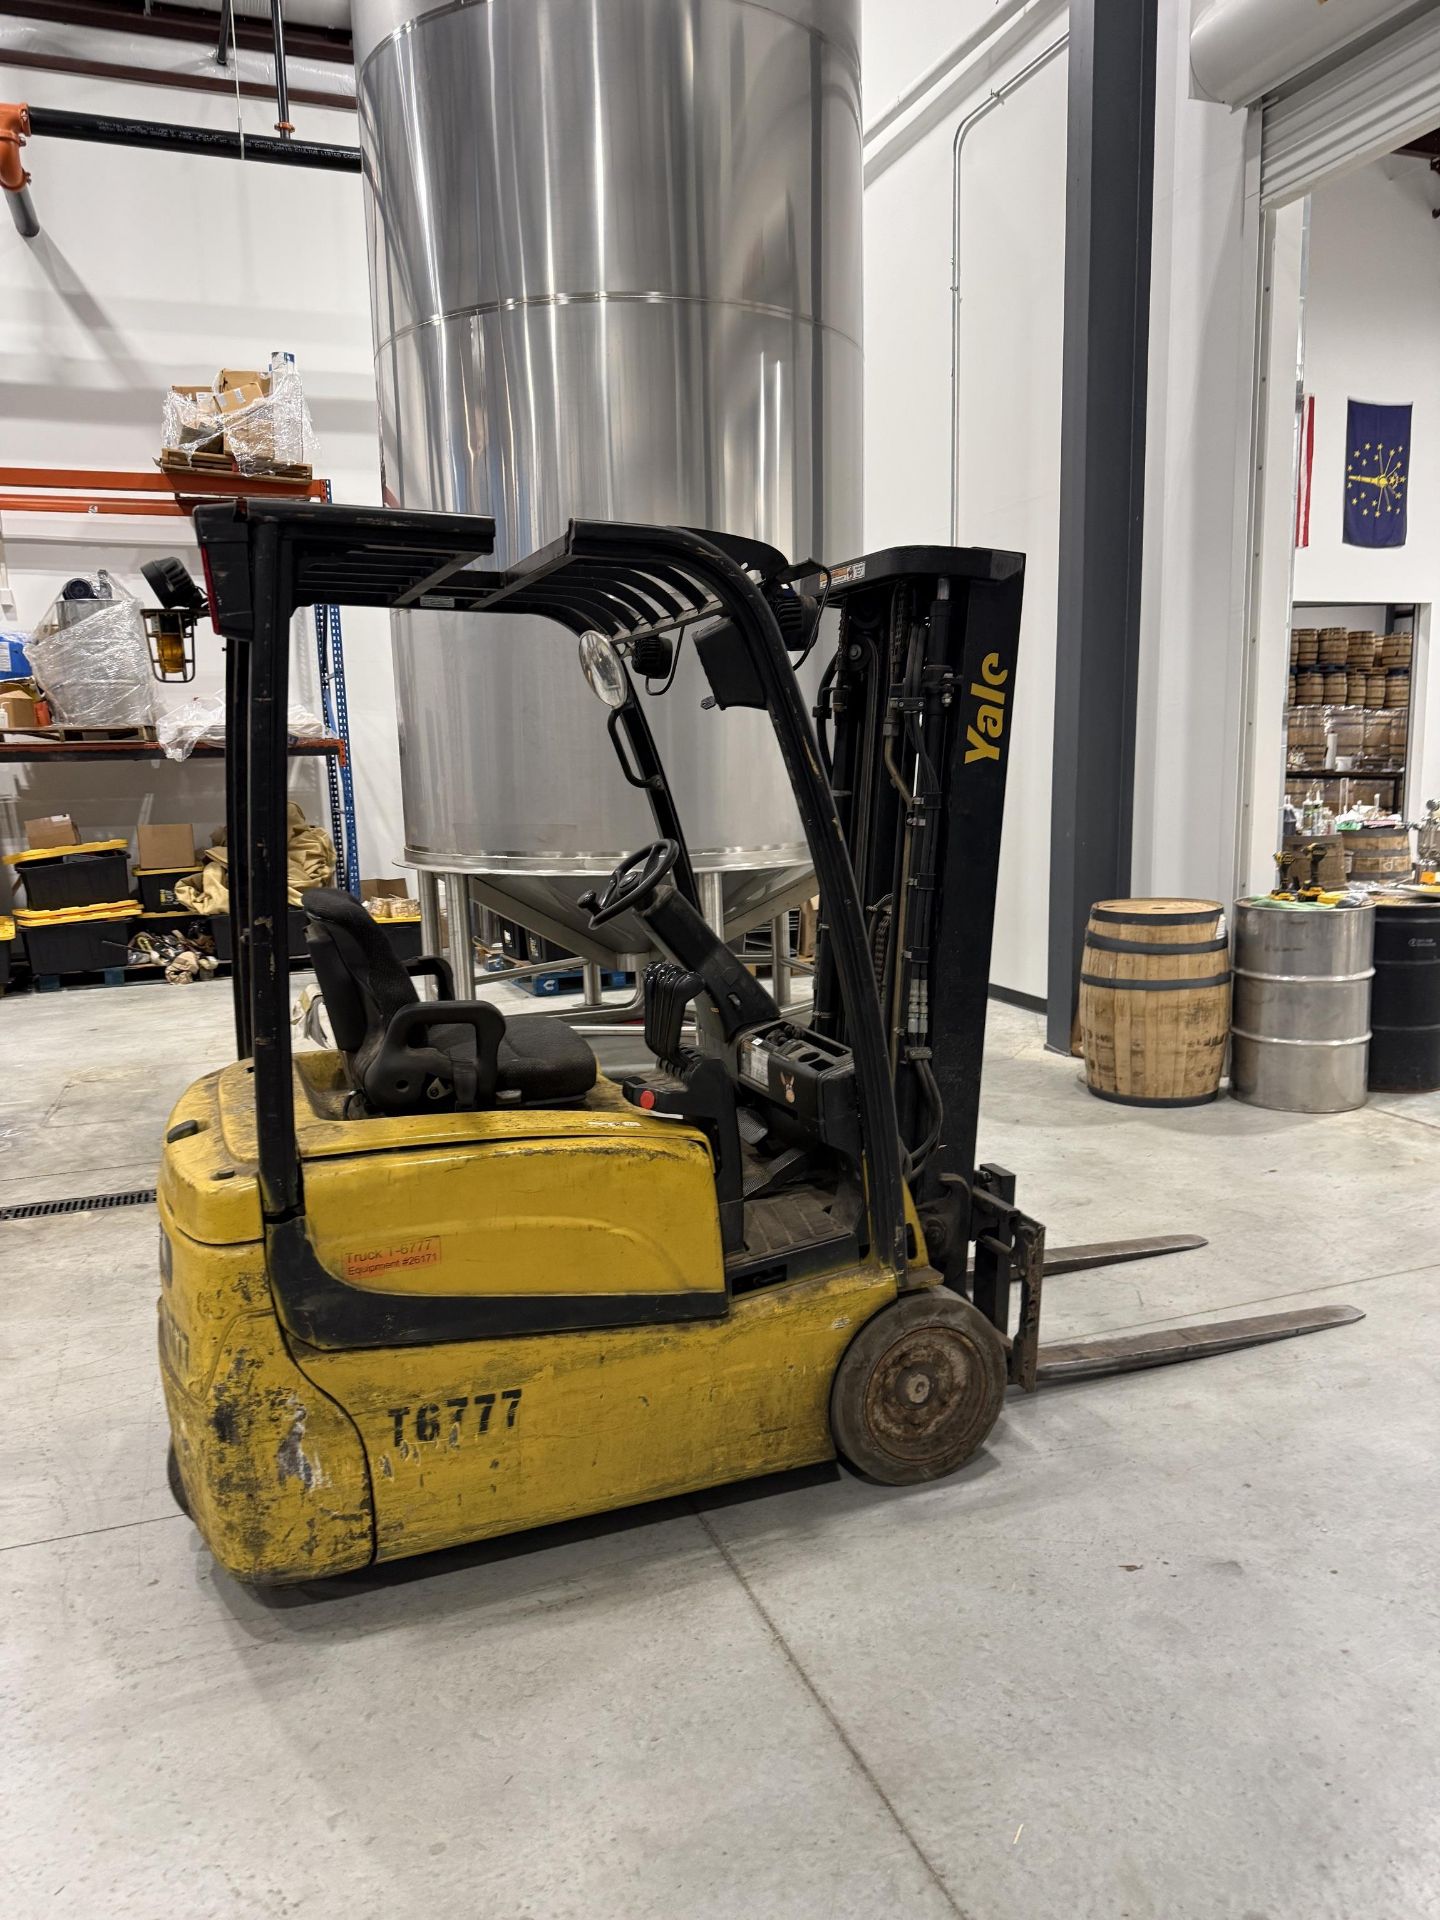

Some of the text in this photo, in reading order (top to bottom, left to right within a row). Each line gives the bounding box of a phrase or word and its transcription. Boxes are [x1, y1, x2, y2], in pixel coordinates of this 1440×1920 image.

[345, 1240, 432, 1263] Truck T-6777
[347, 1253, 437, 1275] Equipment #26171
[387, 1388, 522, 1447] T6777
